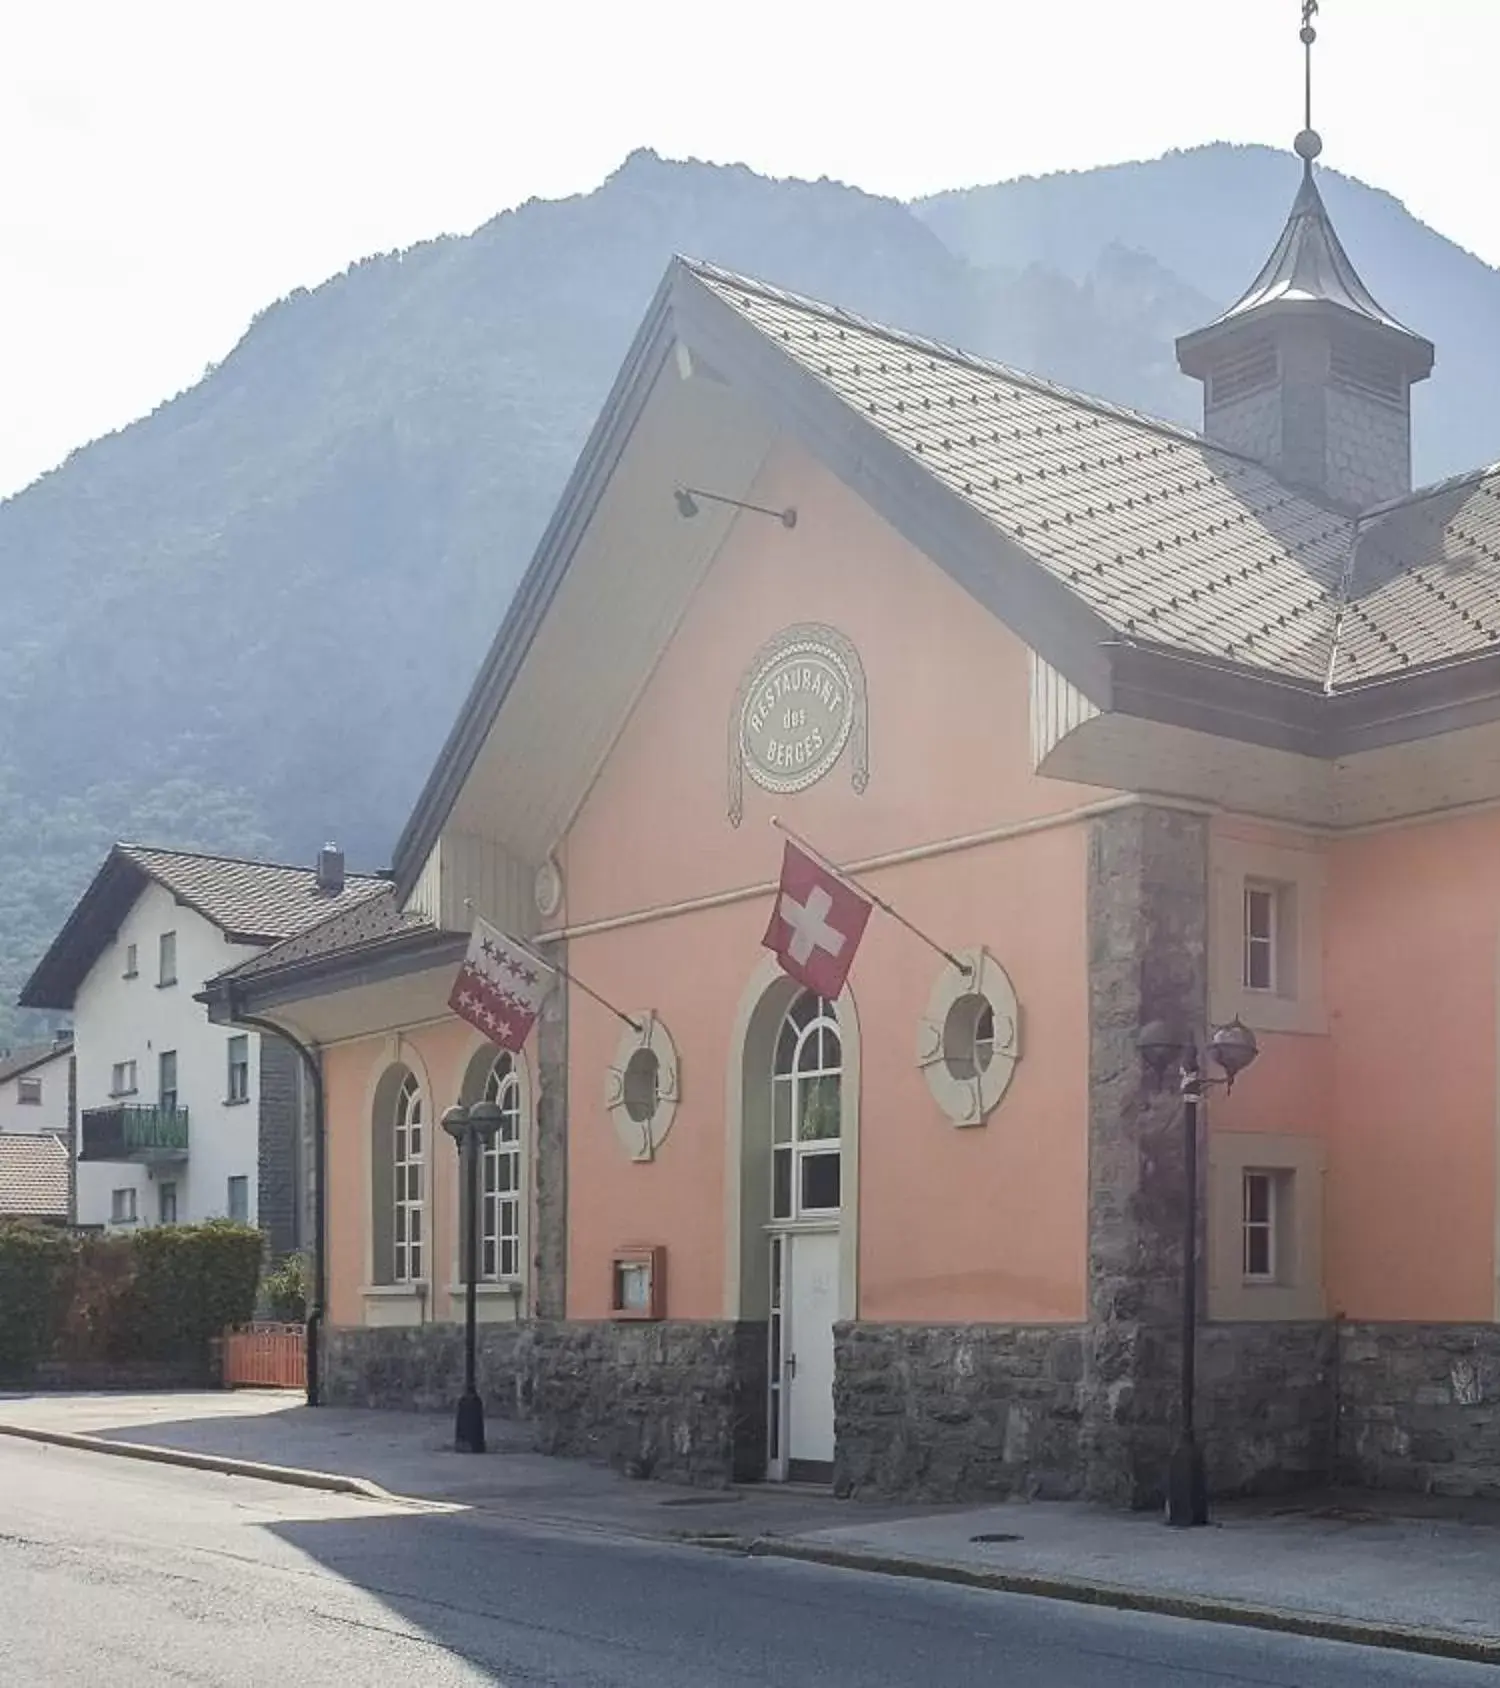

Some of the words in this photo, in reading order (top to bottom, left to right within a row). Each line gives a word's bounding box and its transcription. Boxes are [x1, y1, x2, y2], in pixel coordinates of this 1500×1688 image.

[752, 668, 841, 733] RESTAURANT
[783, 708, 805, 729] des
[767, 728, 823, 767] BERGES
